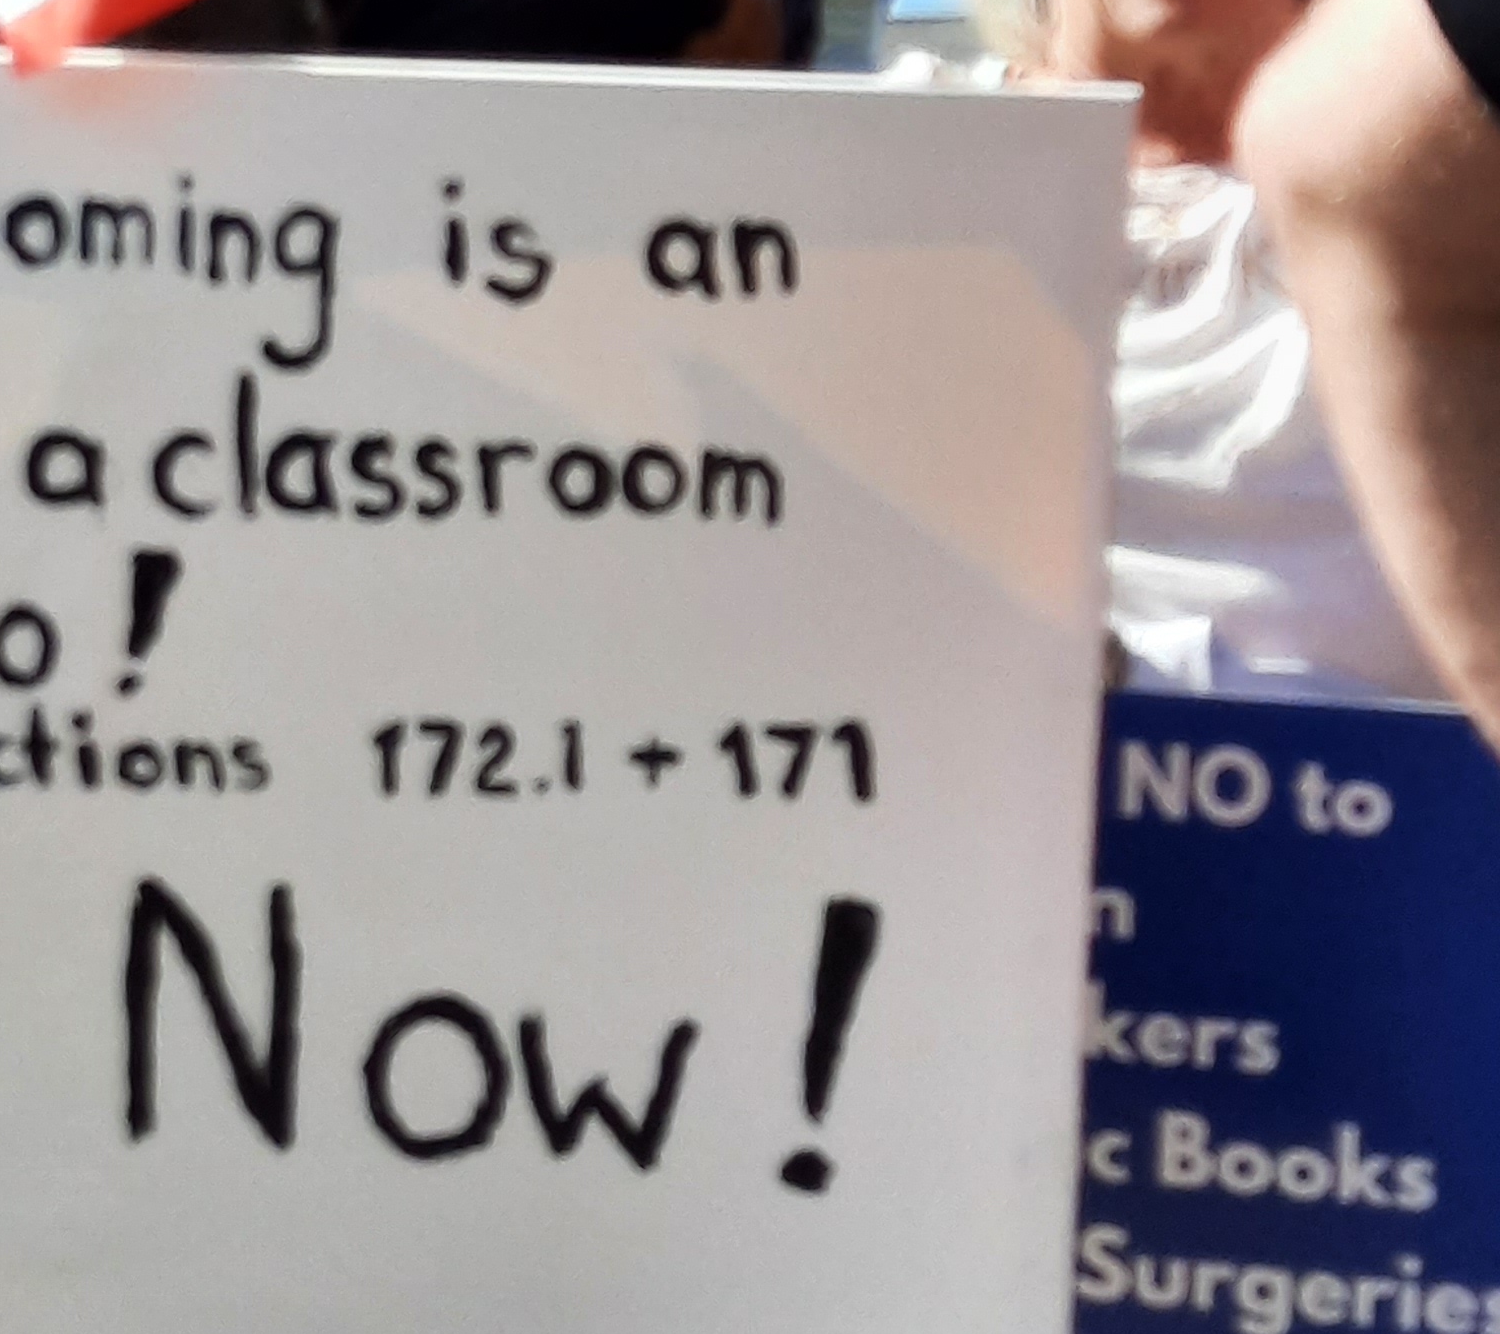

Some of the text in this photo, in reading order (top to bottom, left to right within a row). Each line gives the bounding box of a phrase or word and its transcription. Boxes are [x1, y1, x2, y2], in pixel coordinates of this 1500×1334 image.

[442, 180, 553, 304] is
[645, 218, 797, 299] an
[24, 430, 104, 506] a
[151, 371, 783, 525] classroom
[373, 718, 582, 796] 172.1
[630, 739, 681, 785] +
[718, 719, 874, 802] 171
[1120, 741, 1392, 835] NO to
[1157, 1110, 1436, 1213] Books
